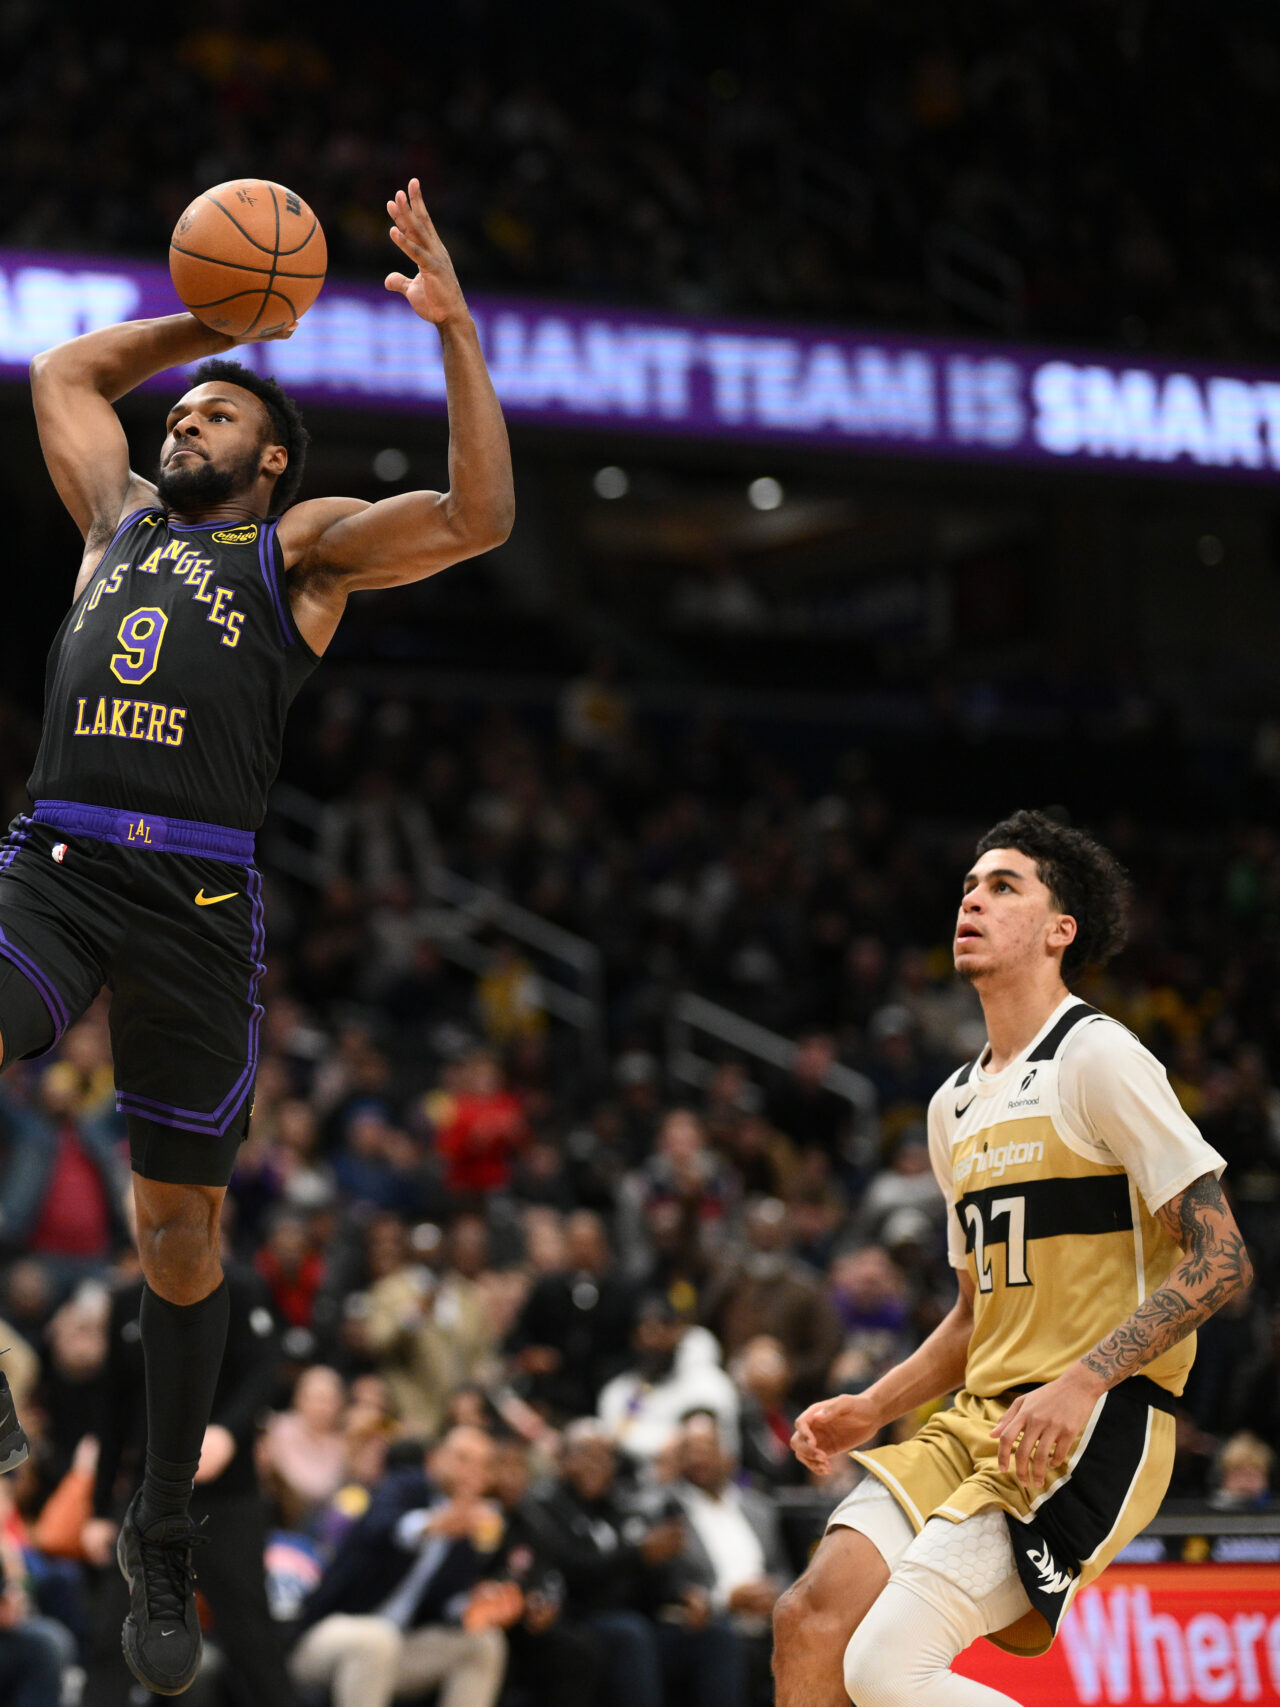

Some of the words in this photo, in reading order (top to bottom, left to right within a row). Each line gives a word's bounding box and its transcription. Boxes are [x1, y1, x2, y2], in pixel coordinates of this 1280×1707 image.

[704, 332, 936, 440] TEAM
[947, 354, 1025, 448] IS
[72, 563, 131, 634] LOS
[137, 539, 246, 648] ANGELES
[110, 606, 169, 686] 9
[73, 696, 188, 746] LAKERS
[127, 818, 152, 844] LAL
[963, 1195, 1033, 1295] 27
